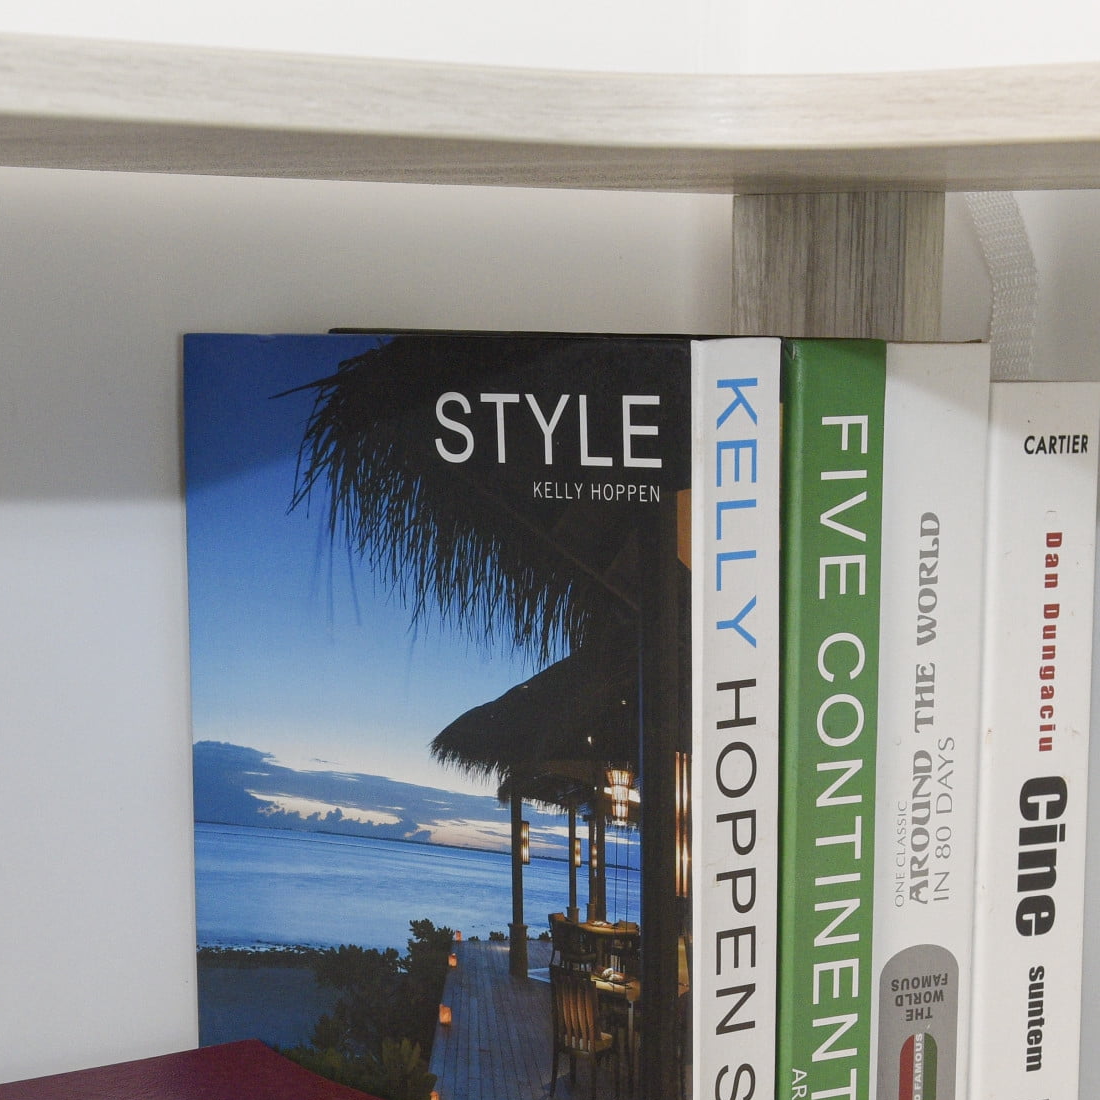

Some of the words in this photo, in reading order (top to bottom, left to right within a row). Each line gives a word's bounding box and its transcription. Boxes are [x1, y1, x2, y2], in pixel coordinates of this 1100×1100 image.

[434, 391, 663, 468] STYLE
[1023, 434, 1089, 455] CARTIER
[533, 480, 584, 500] KELLY
[591, 482, 661, 503] HOPPEN
[716, 377, 758, 649] KELLY
[818, 413, 869, 600] FIVE
[916, 511, 941, 647] WORLD
[1044, 531, 1063, 589] Dan
[914, 662, 936, 734] THE
[1038, 603, 1061, 752] Dungaciu
[935, 736, 956, 815] DAYS
[715, 678, 757, 1036] HOPPEN
[895, 801, 908, 868] CLASSIC
[908, 749, 934, 905] AROUND
[934, 825, 953, 860] 80
[1014, 775, 1069, 937] Cine
[894, 872, 906, 908] ONE
[933, 871, 951, 902] IN
[890, 972, 949, 992] FAMOUS
[894, 989, 945, 1007] WORLD
[905, 1006, 933, 1022] THE
[1025, 965, 1046, 1073] suntem
[914, 1032, 923, 1090] FAMOUS
